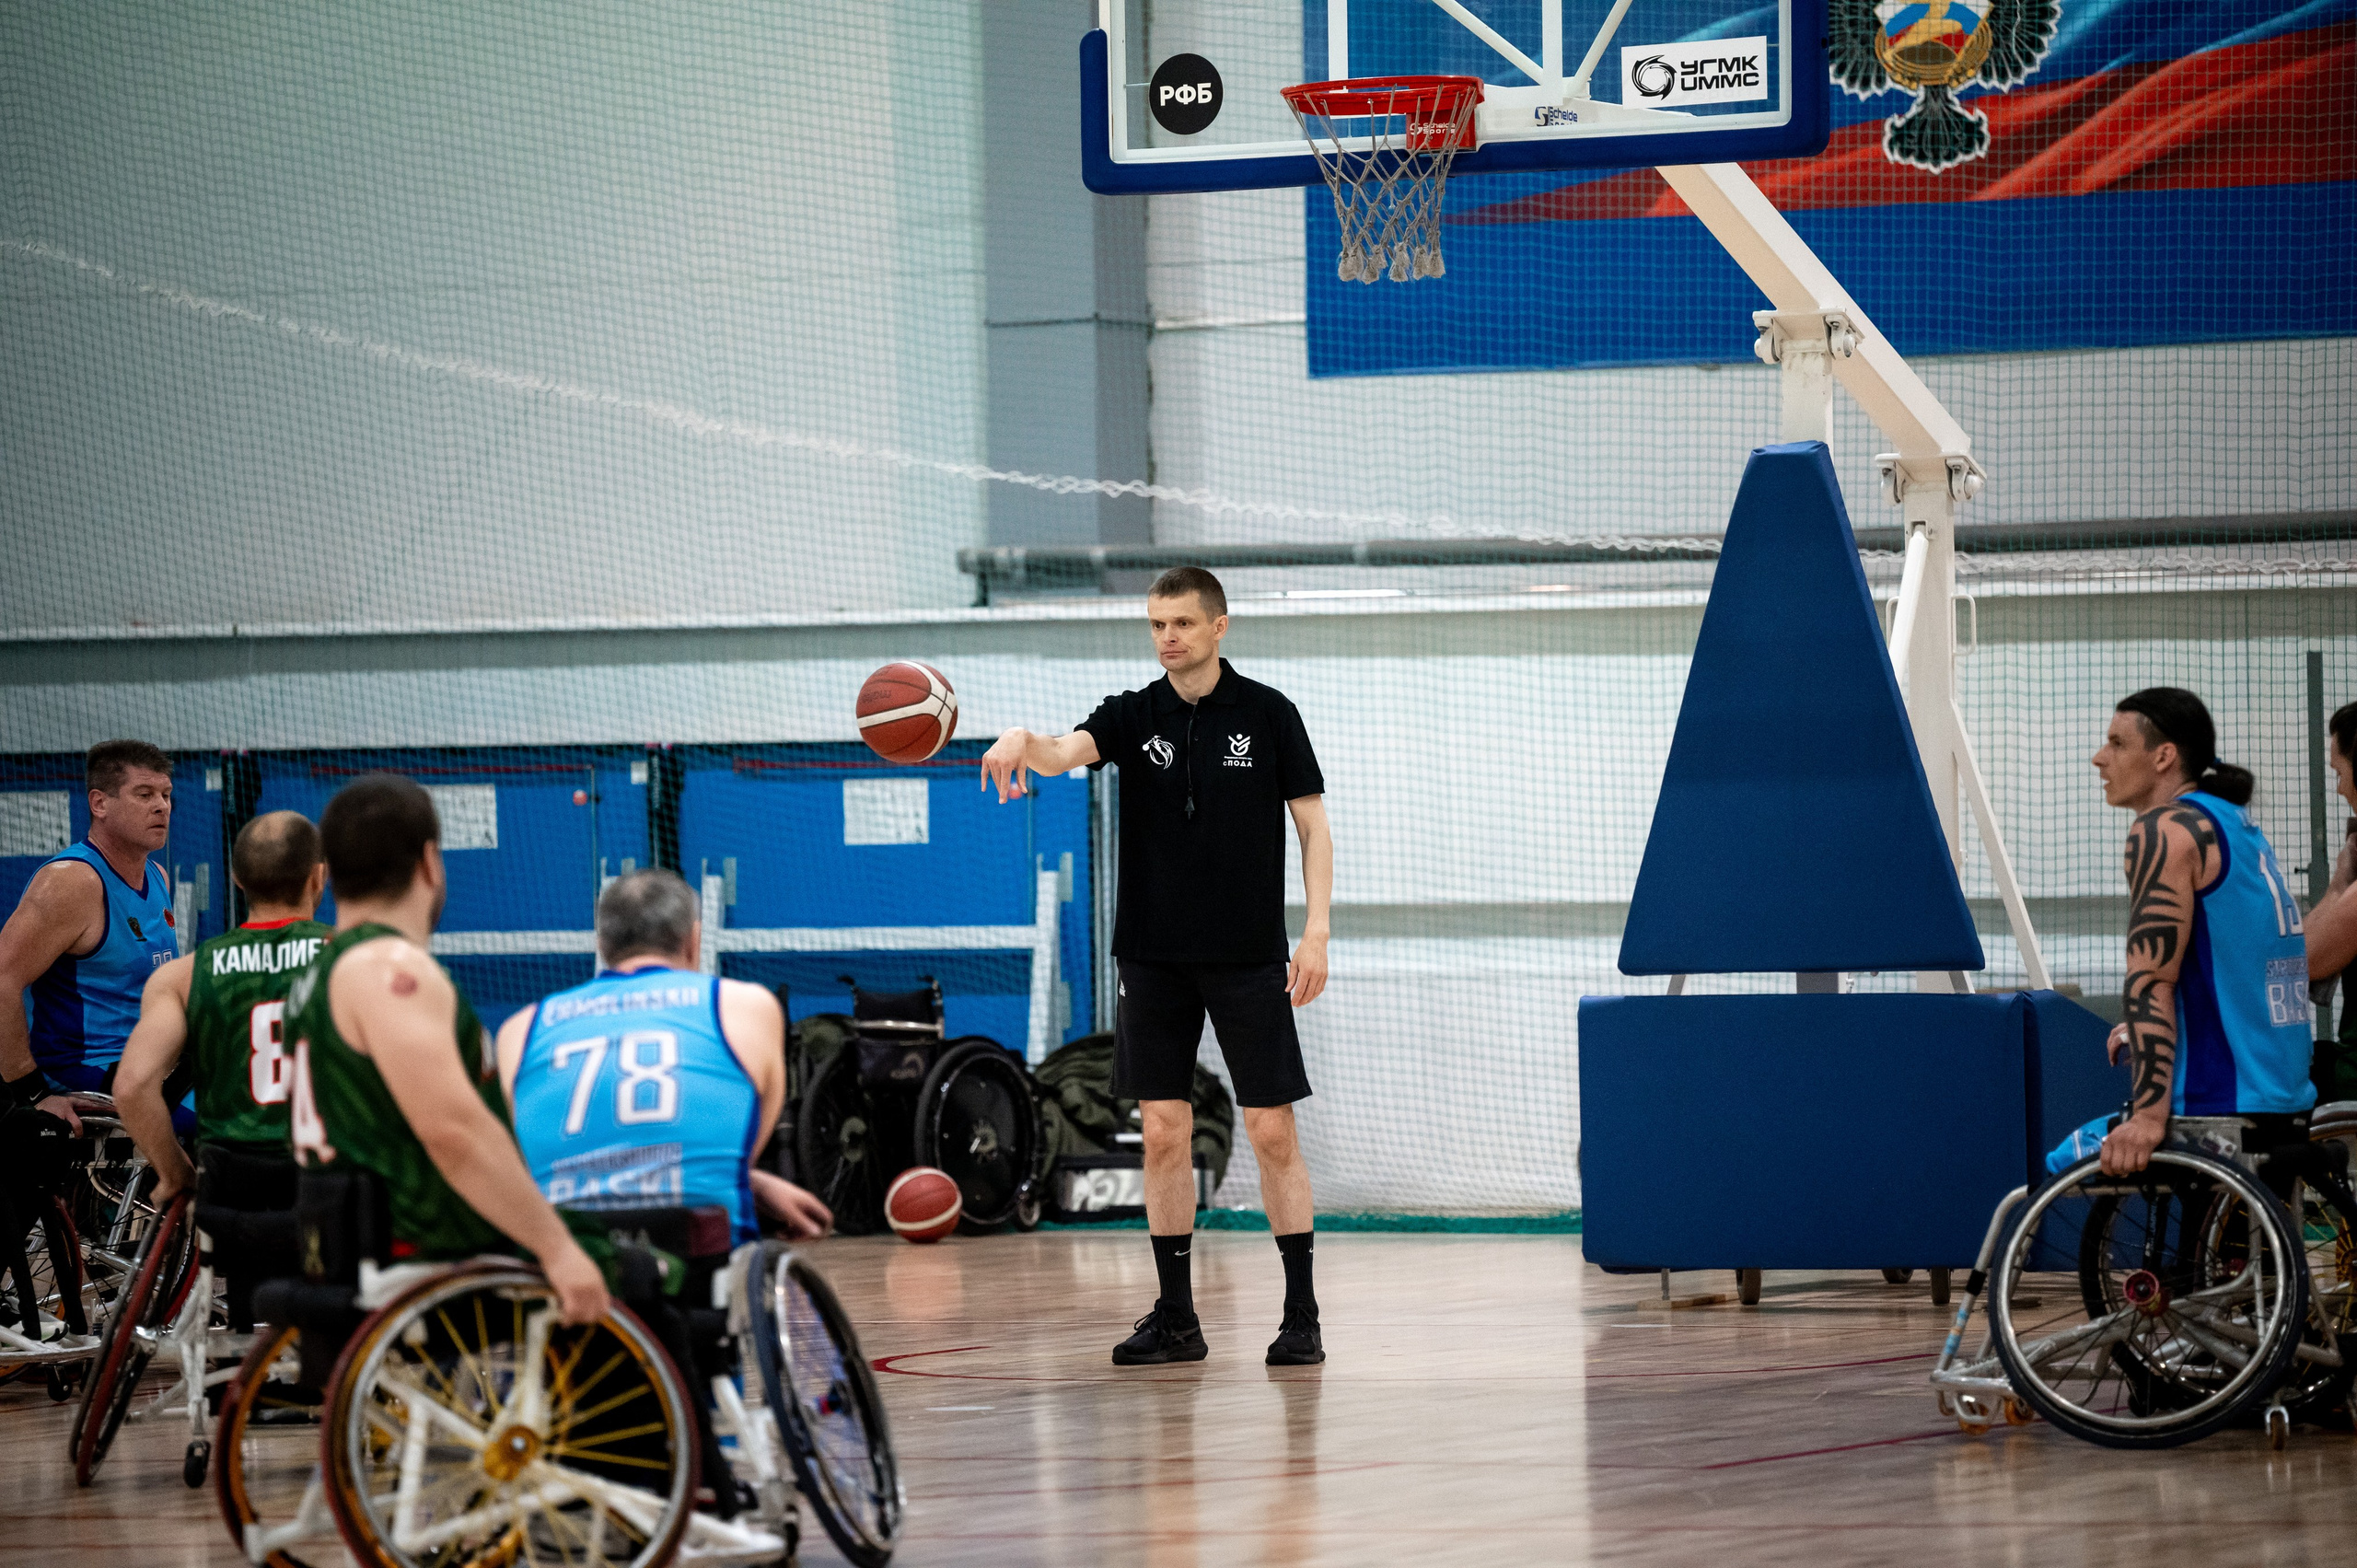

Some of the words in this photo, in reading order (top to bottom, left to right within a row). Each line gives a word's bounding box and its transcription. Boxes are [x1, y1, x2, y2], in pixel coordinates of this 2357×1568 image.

[1681, 55, 1759, 75] УГМК
[1681, 73, 1759, 91] UMMC
[1159, 83, 1213, 106] РФБ
[552, 1030, 679, 1135] 78
